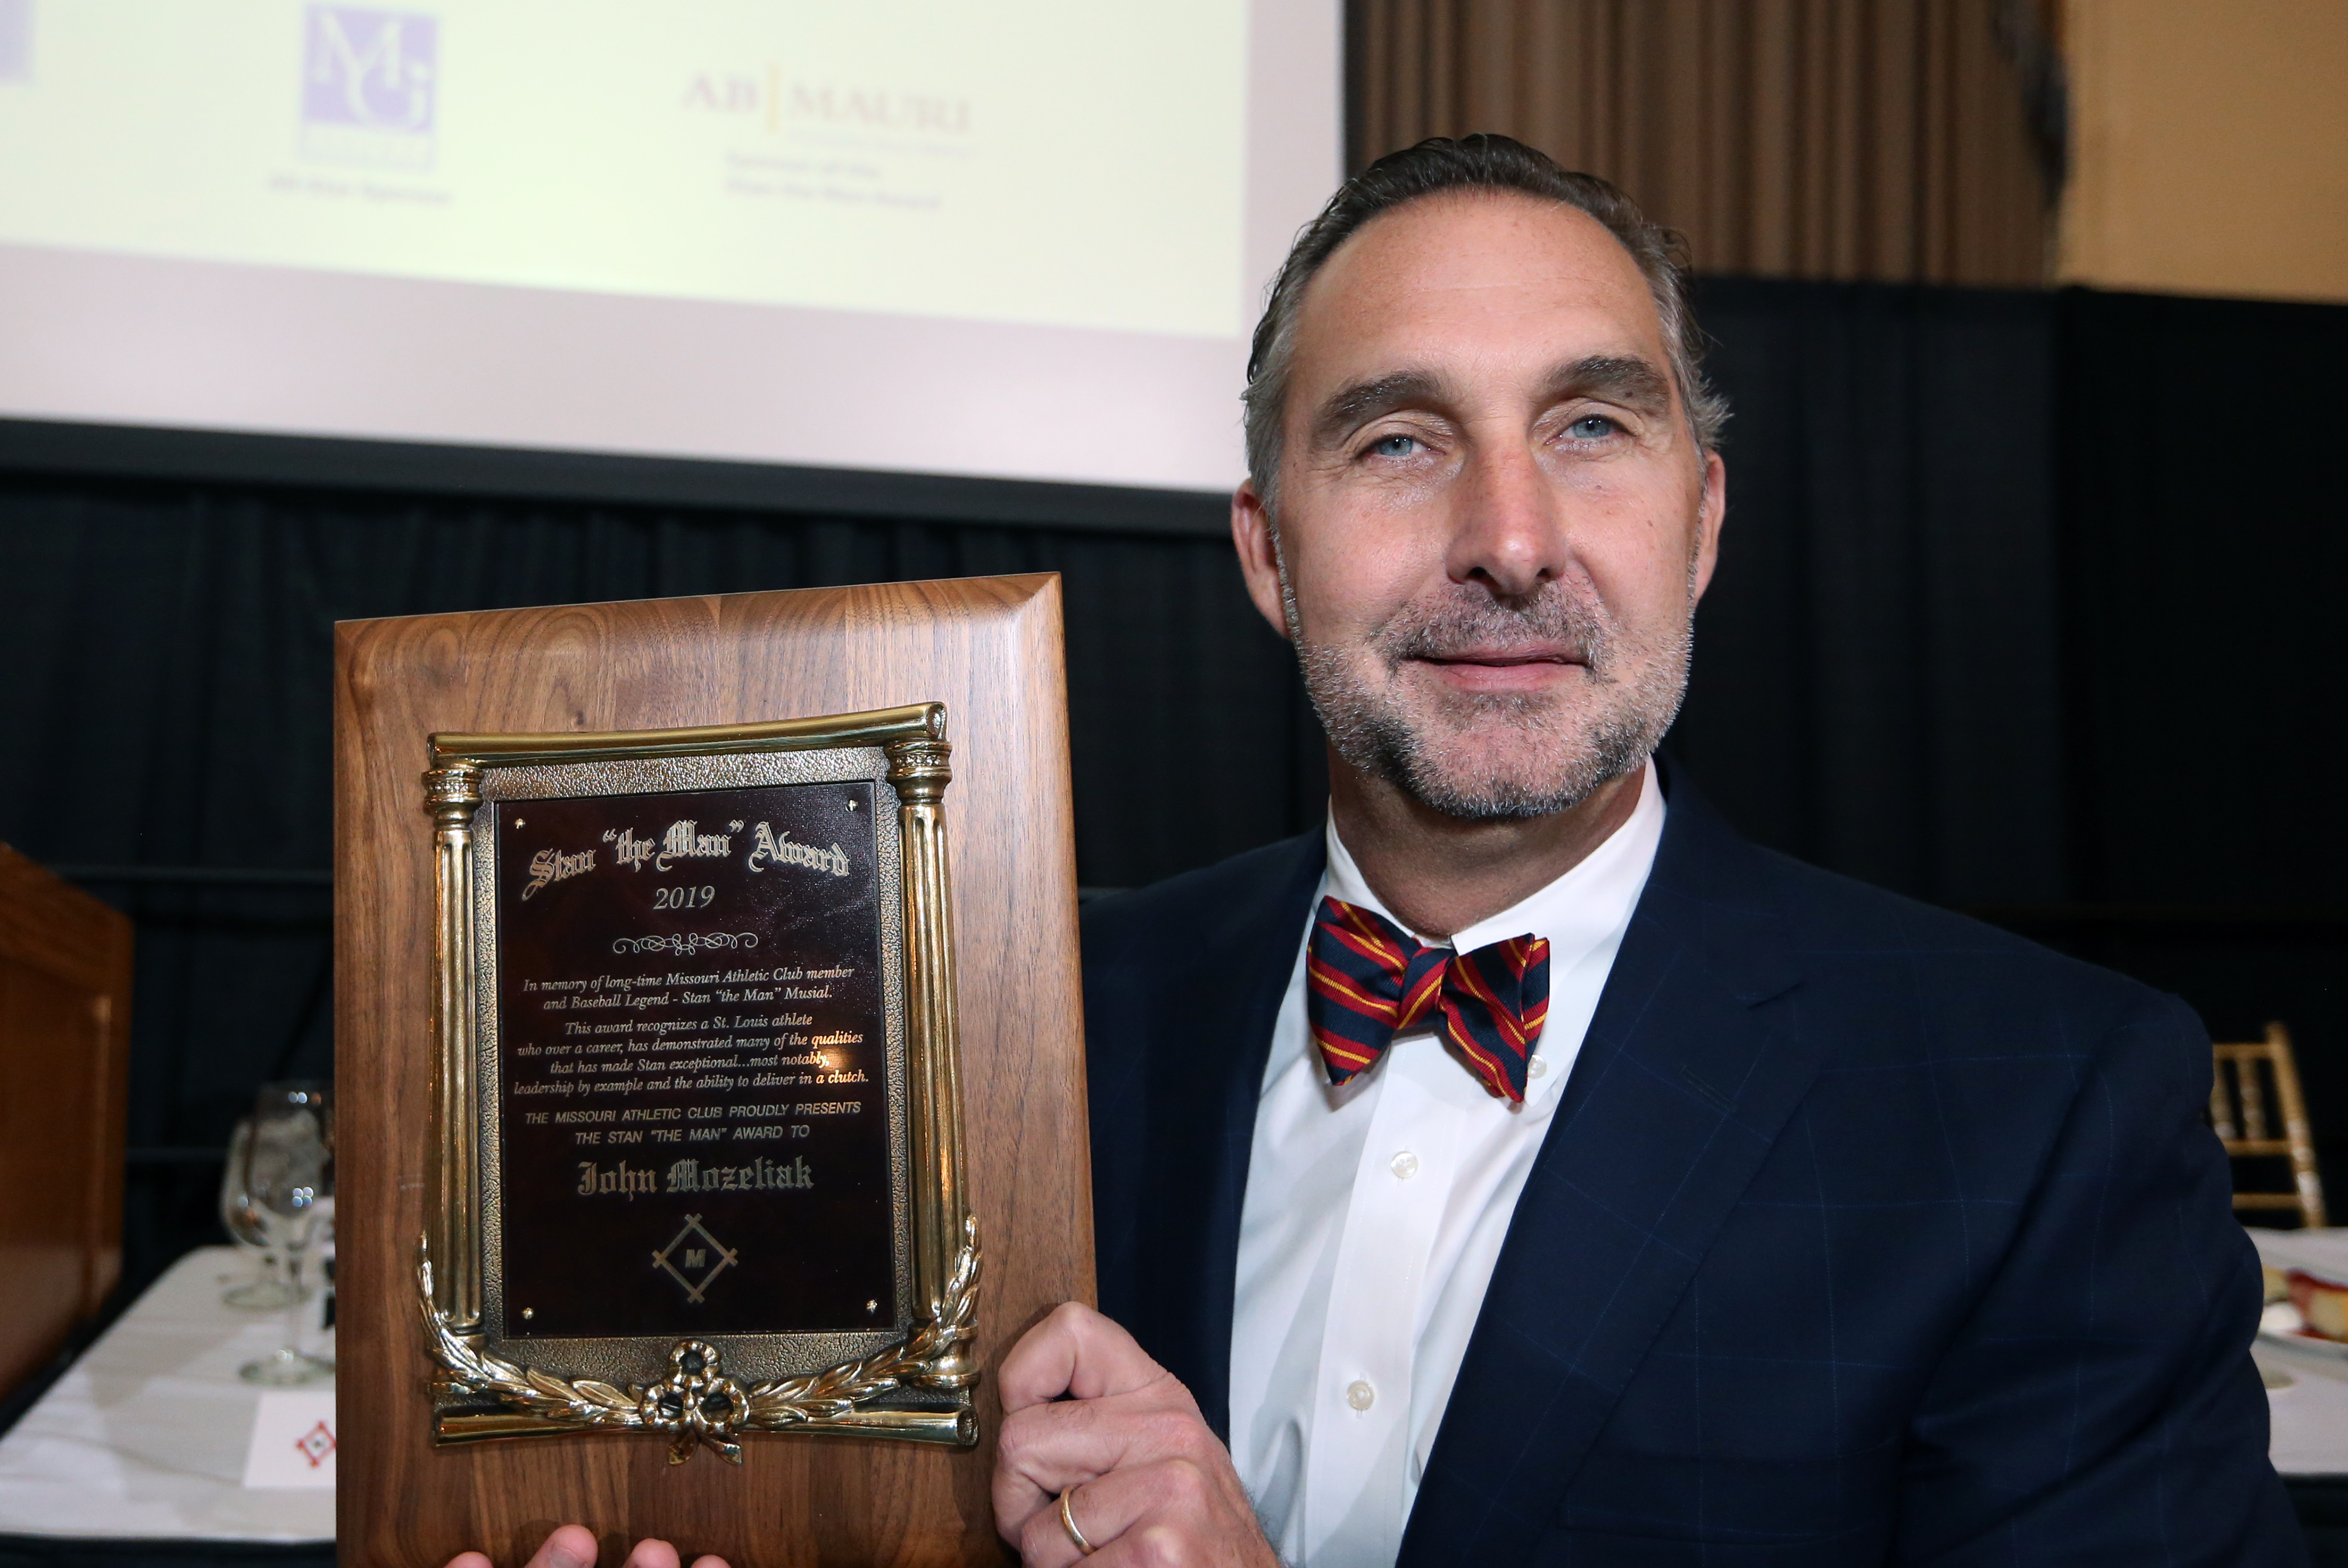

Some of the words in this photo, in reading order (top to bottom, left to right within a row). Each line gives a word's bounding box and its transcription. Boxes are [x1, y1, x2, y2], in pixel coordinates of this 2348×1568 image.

[522, 848, 596, 901] Stan
[748, 821, 850, 877] Award
[653, 885, 715, 910] 2019
[523, 979, 538, 992] In
[541, 980, 586, 993] memory
[591, 975, 606, 993] of
[606, 974, 662, 991] long-time
[666, 970, 720, 986] Missouri
[722, 969, 769, 983] Athletic
[773, 967, 802, 981] Club
[807, 965, 855, 979] member
[544, 997, 566, 1010] and
[571, 994, 621, 1009] Baseball
[625, 992, 669, 1010] Legend
[682, 992, 711, 1004] Stan
[785, 985, 832, 999] Musial.
[565, 1021, 591, 1034] This
[595, 1020, 633, 1033] award
[637, 1018, 697, 1035] recognizes
[701, 1021, 709, 1029] a
[713, 1016, 729, 1029] St.
[734, 1014, 768, 1027] Louis
[772, 1013, 813, 1027] athlete
[518, 1043, 541, 1056] who
[545, 1045, 572, 1055] over
[575, 1046, 582, 1054] a
[586, 1043, 623, 1054] career,
[628, 1039, 648, 1051] has
[652, 1036, 733, 1051] demonstrated
[736, 1038, 770, 1051] many
[774, 1033, 788, 1050] of
[790, 1032, 807, 1045] the
[811, 1030, 863, 1048] qualities
[551, 1061, 573, 1074] that
[578, 1060, 598, 1073] has
[601, 1059, 633, 1072] made
[637, 1059, 666, 1071] Stan
[782, 1051, 830, 1068] notably,
[514, 1081, 574, 1097] leadership
[578, 1080, 591, 1097] by
[594, 1078, 643, 1095] example
[647, 1077, 671, 1090] and
[674, 1076, 692, 1089] the
[696, 1074, 734, 1091] ability
[738, 1076, 749, 1087] to
[753, 1072, 795, 1086] deliver
[799, 1073, 812, 1084] in
[816, 1074, 825, 1084] a
[828, 1070, 869, 1084] clutch.
[525, 1112, 549, 1124] THE
[555, 1110, 616, 1123] MISSOURI
[622, 1108, 682, 1121] ATHLETIC
[688, 1107, 723, 1119] CLUB
[729, 1104, 790, 1117] PROUDLY
[795, 1101, 861, 1115] PRESENTS
[575, 1132, 602, 1144] THE
[608, 1131, 643, 1144] STAN
[733, 1125, 782, 1139] AWARD
[791, 1124, 810, 1138] TO
[578, 1160, 657, 1202] John
[666, 1155, 814, 1192] Mozeliak
[685, 1249, 706, 1267] M
